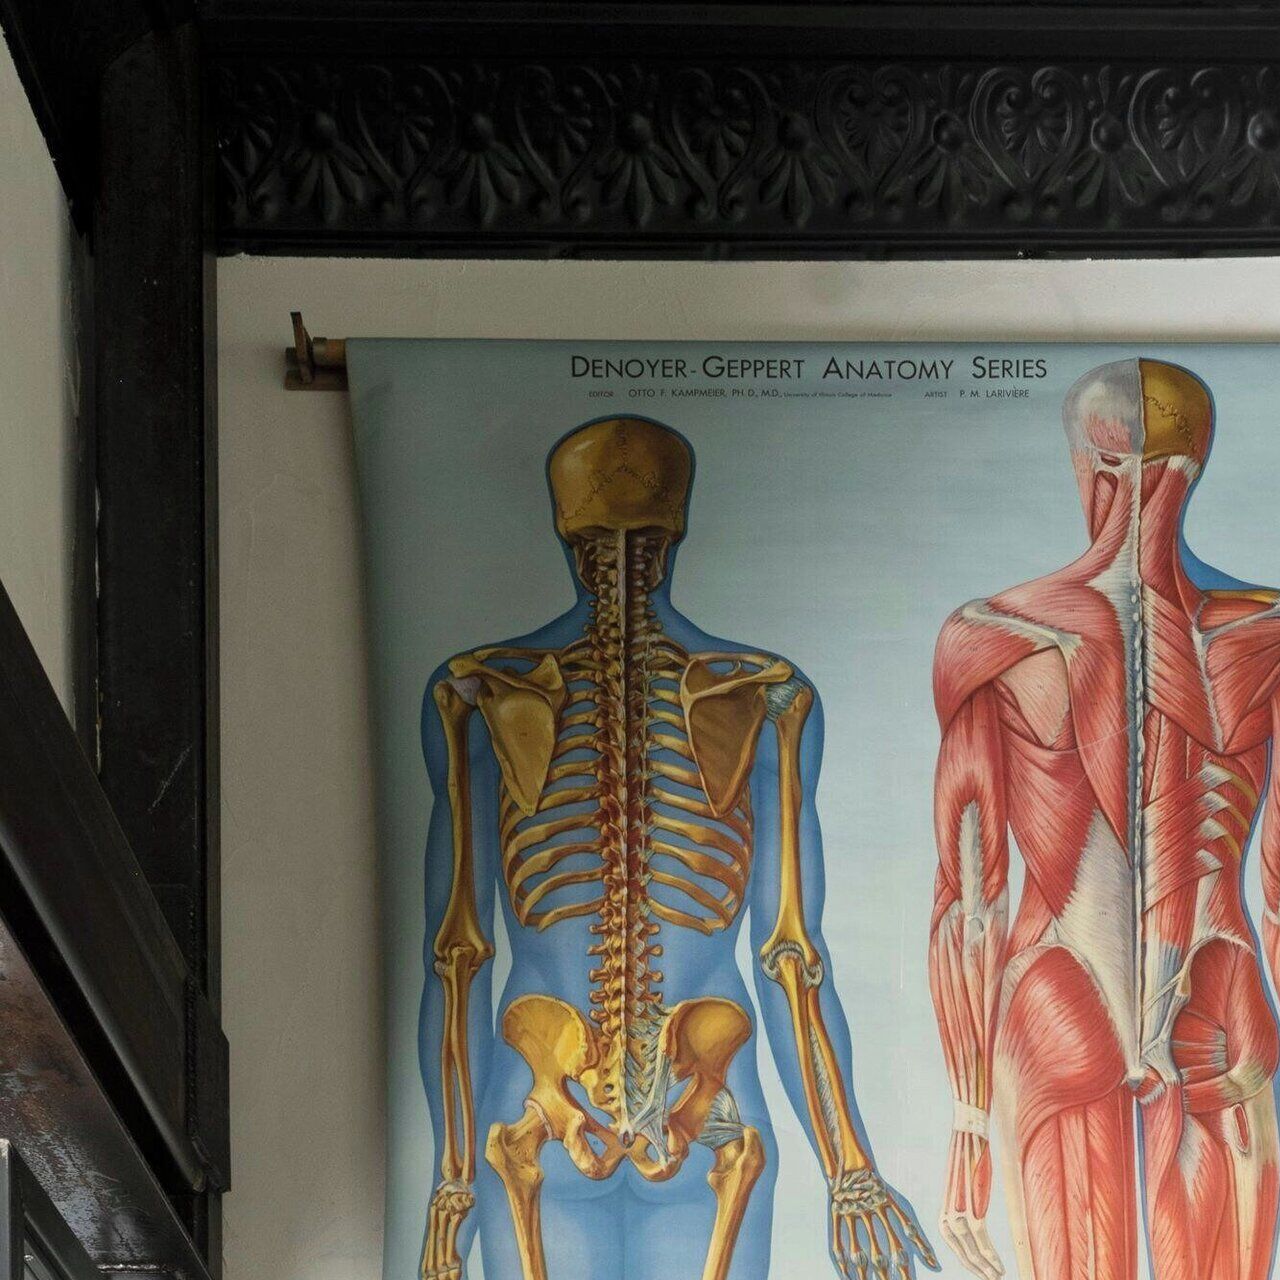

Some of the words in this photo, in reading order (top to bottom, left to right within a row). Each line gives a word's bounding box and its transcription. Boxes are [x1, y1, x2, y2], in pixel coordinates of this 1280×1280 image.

[822, 356, 954, 379] ANATOMY
[972, 356, 1047, 378] SERIES
[628, 389, 655, 397] OTTO
